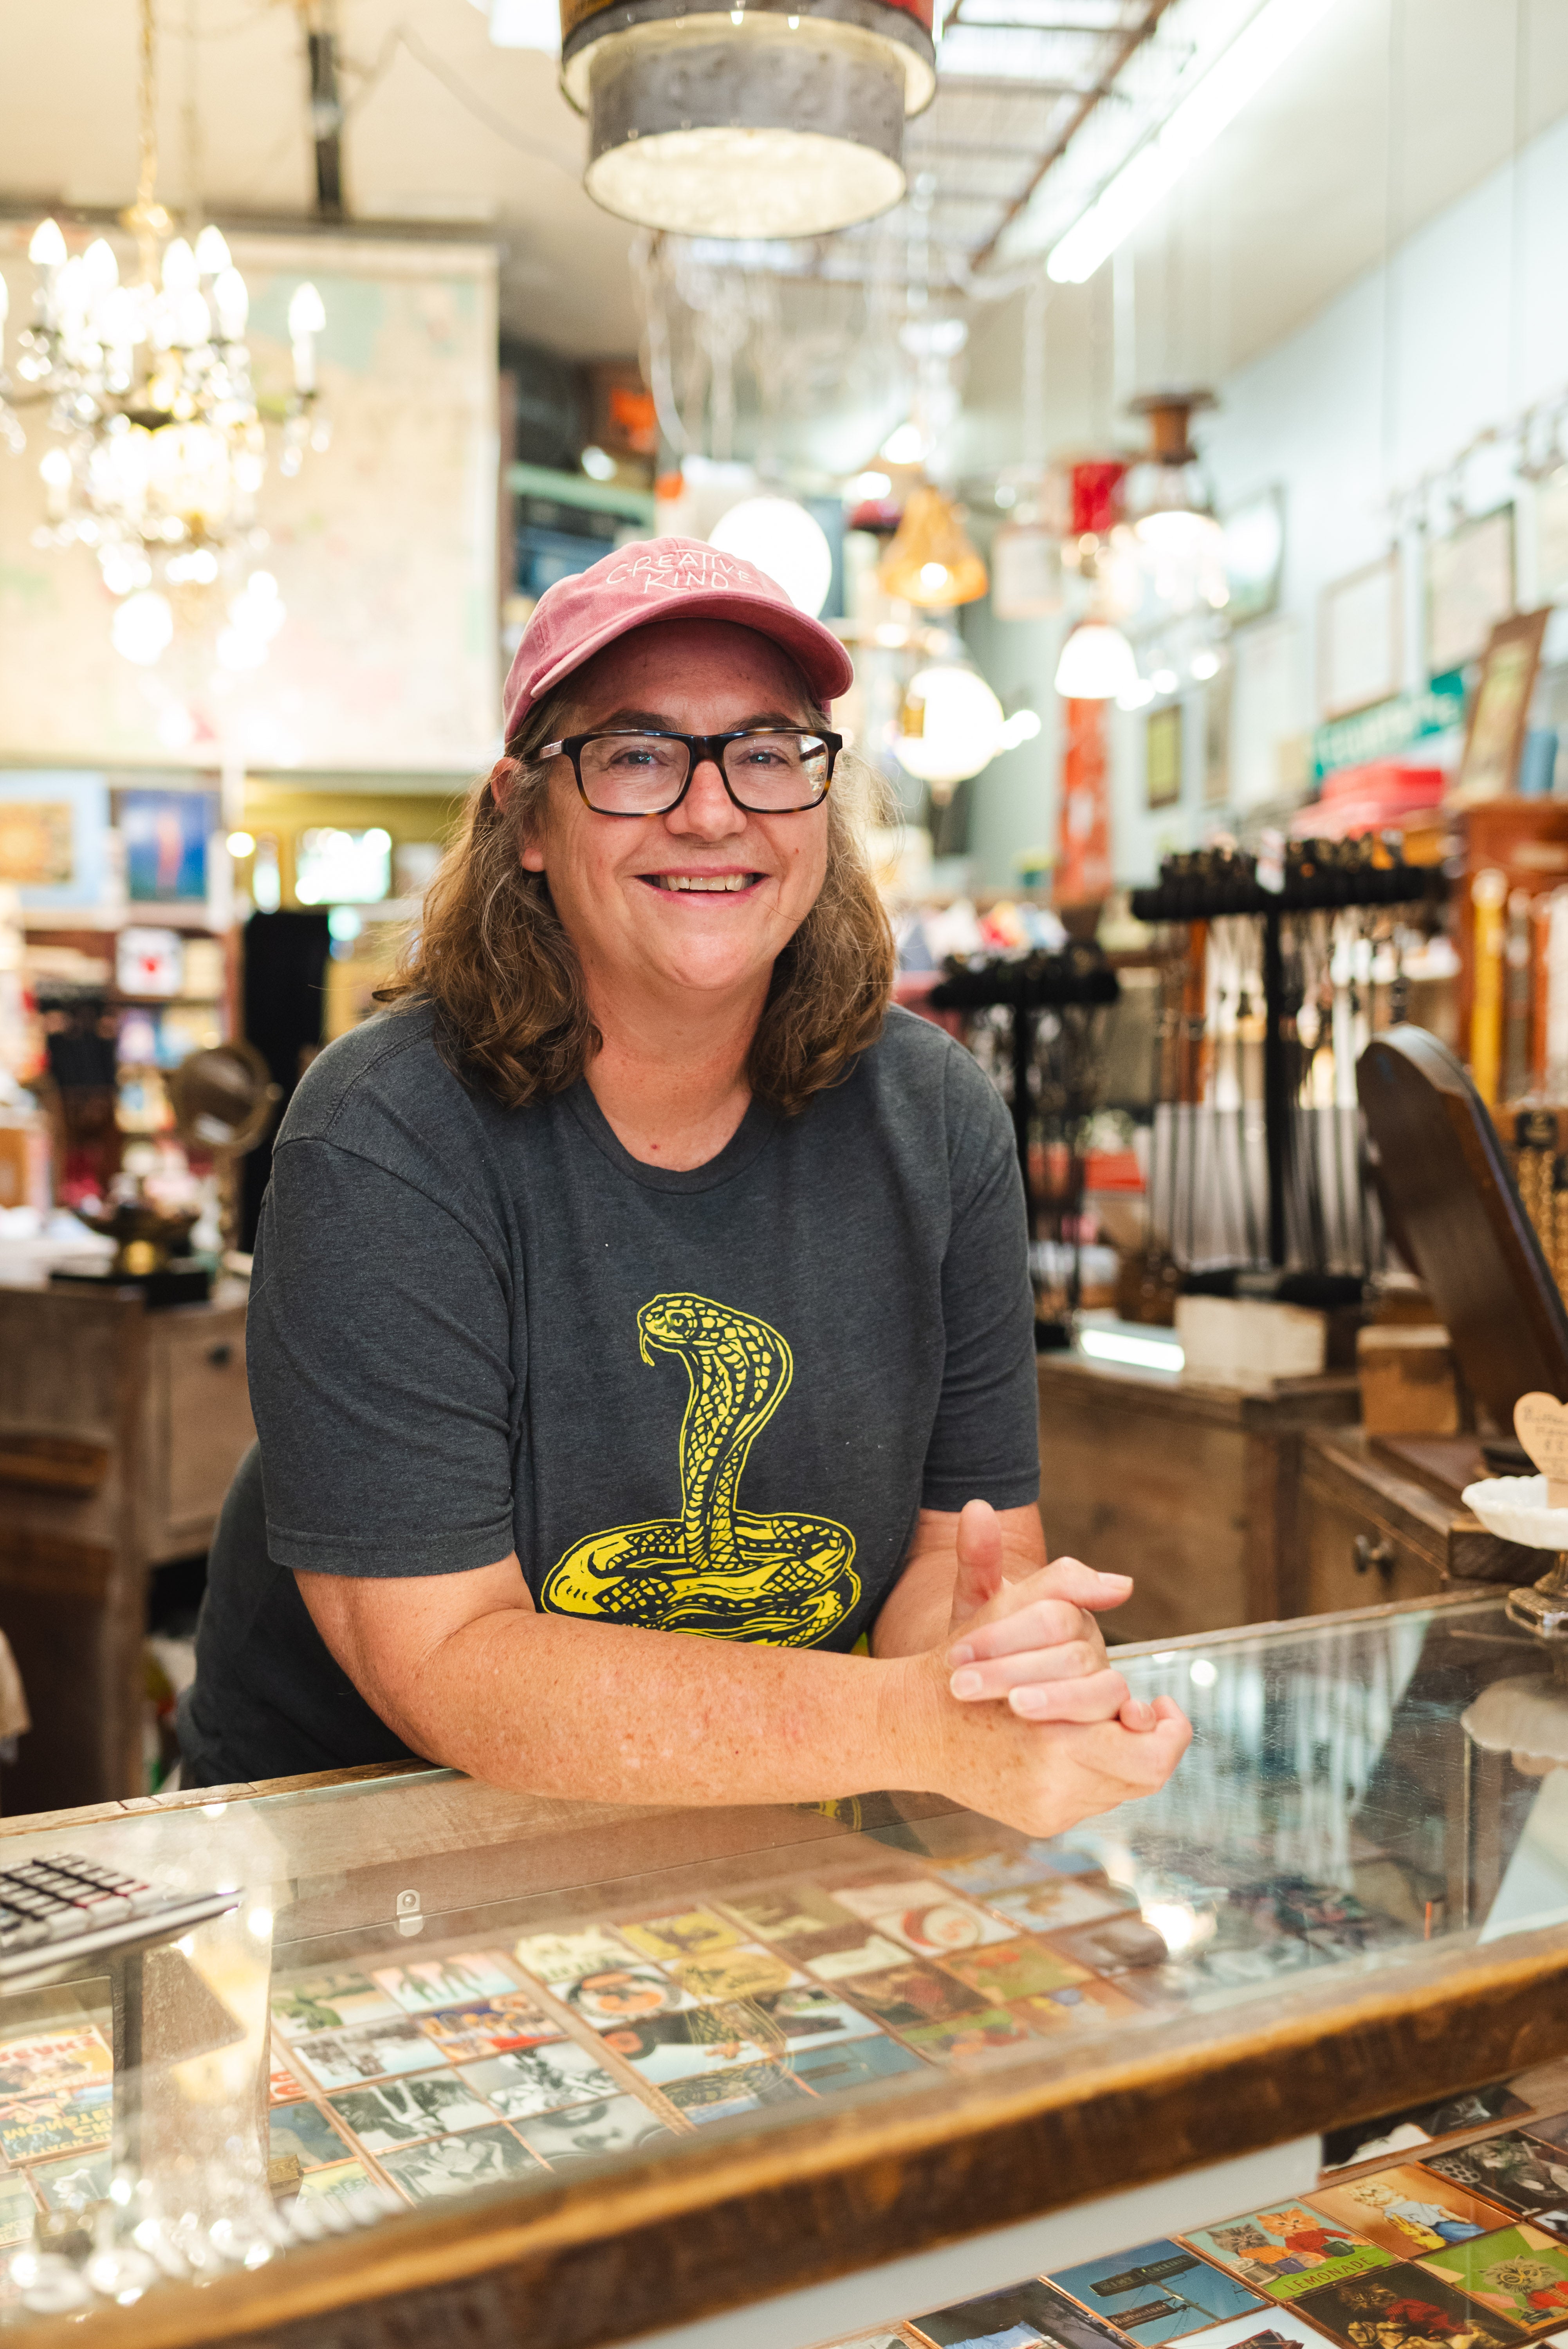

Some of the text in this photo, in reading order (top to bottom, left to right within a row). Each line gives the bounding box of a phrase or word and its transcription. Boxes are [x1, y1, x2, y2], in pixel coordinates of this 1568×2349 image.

[606, 549, 752, 584] CREATIVE
[643, 571, 729, 594] KIND
[1283, 2257, 1375, 2291] LEMONADE
